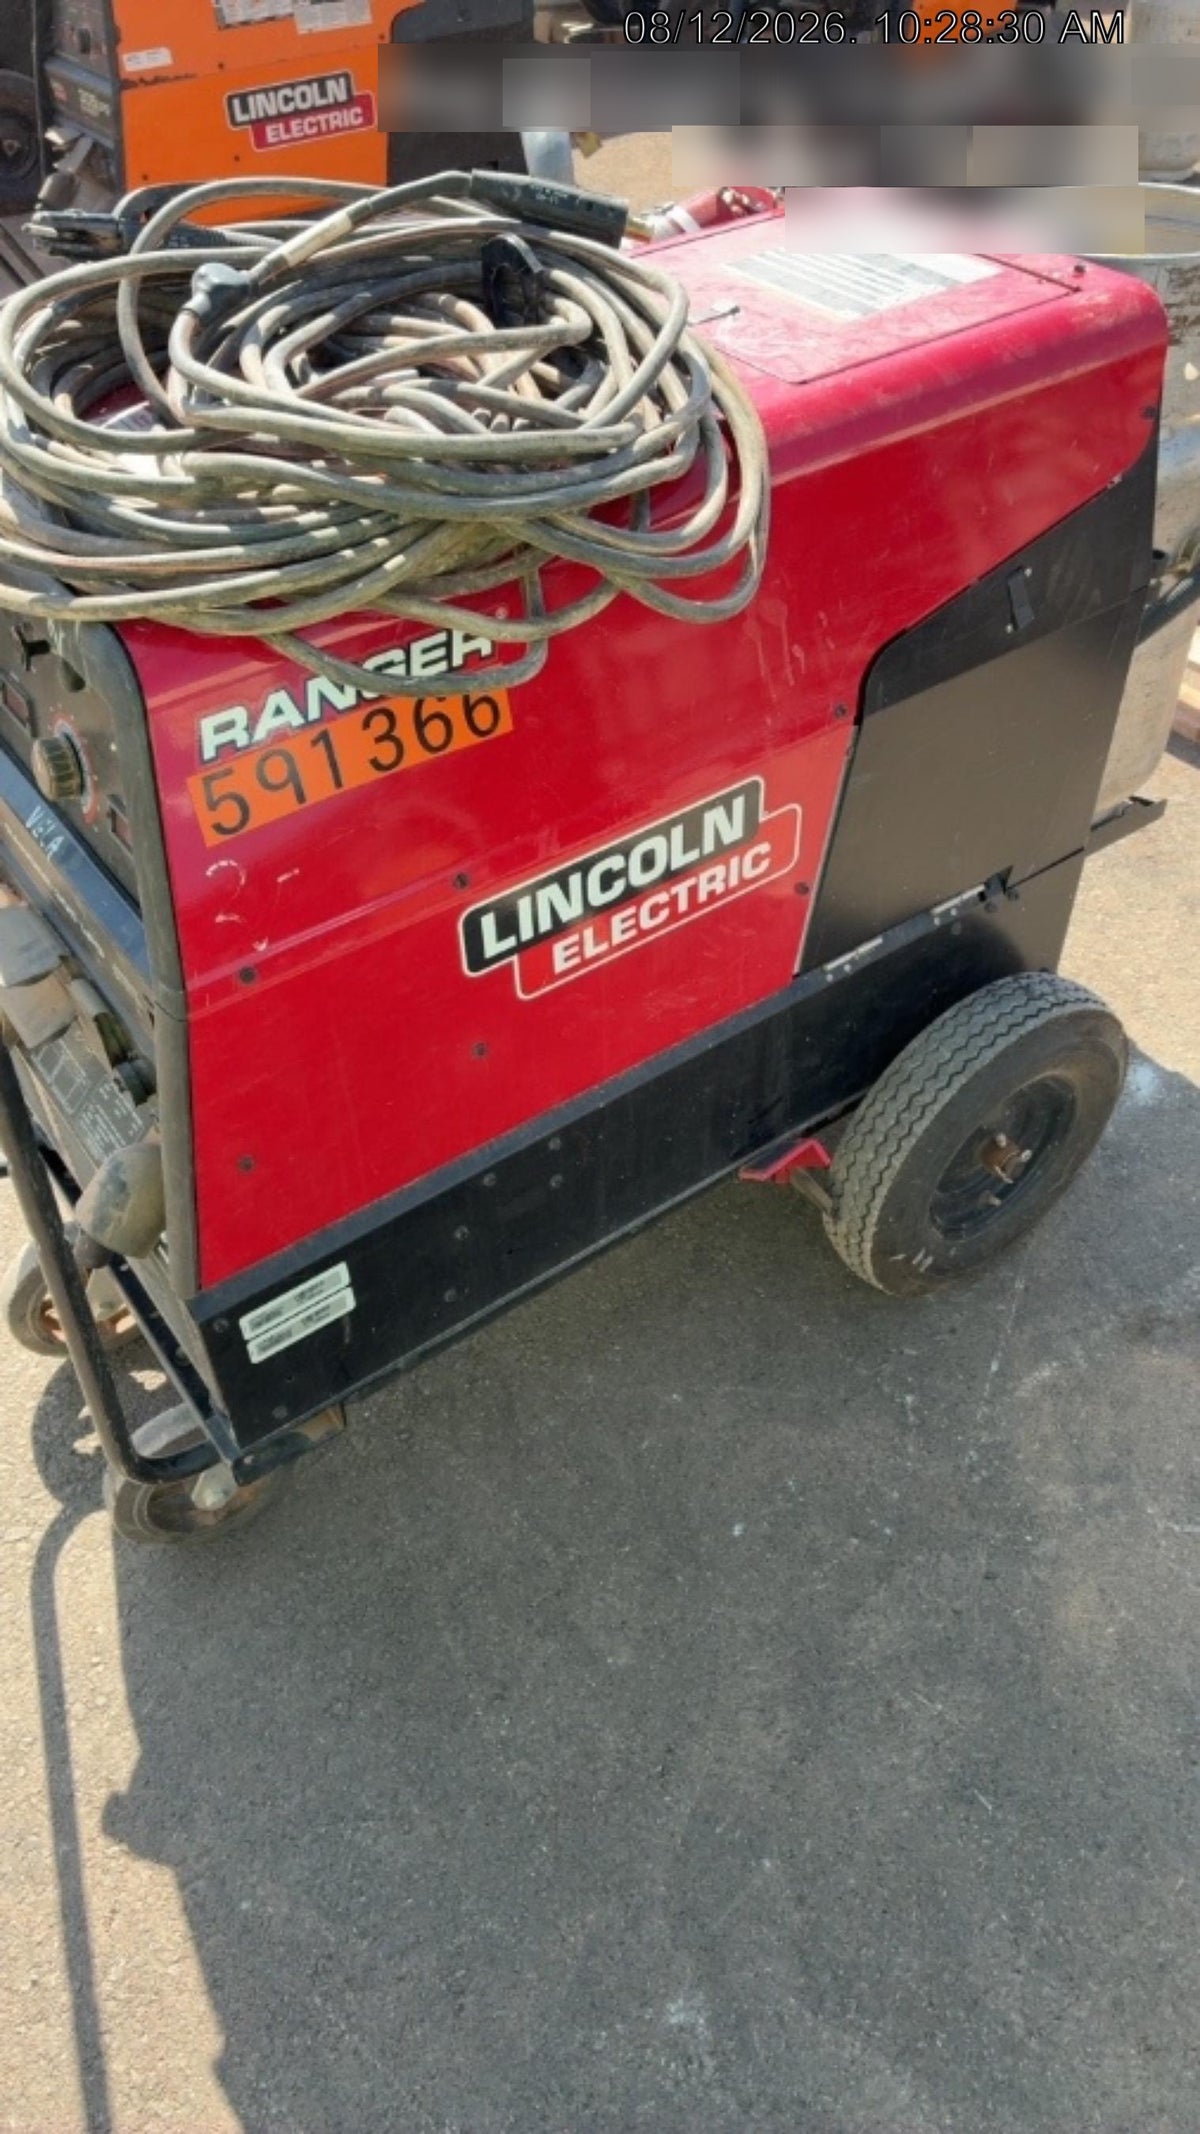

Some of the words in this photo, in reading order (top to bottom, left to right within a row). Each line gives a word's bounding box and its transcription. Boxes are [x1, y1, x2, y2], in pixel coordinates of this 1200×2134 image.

[231, 77, 348, 123] LINCOLN
[265, 106, 364, 143] ELECTRIC
[201, 690, 501, 836] 591366
[480, 794, 746, 959] LINCOLN
[552, 842, 772, 975] ELECTRIC
